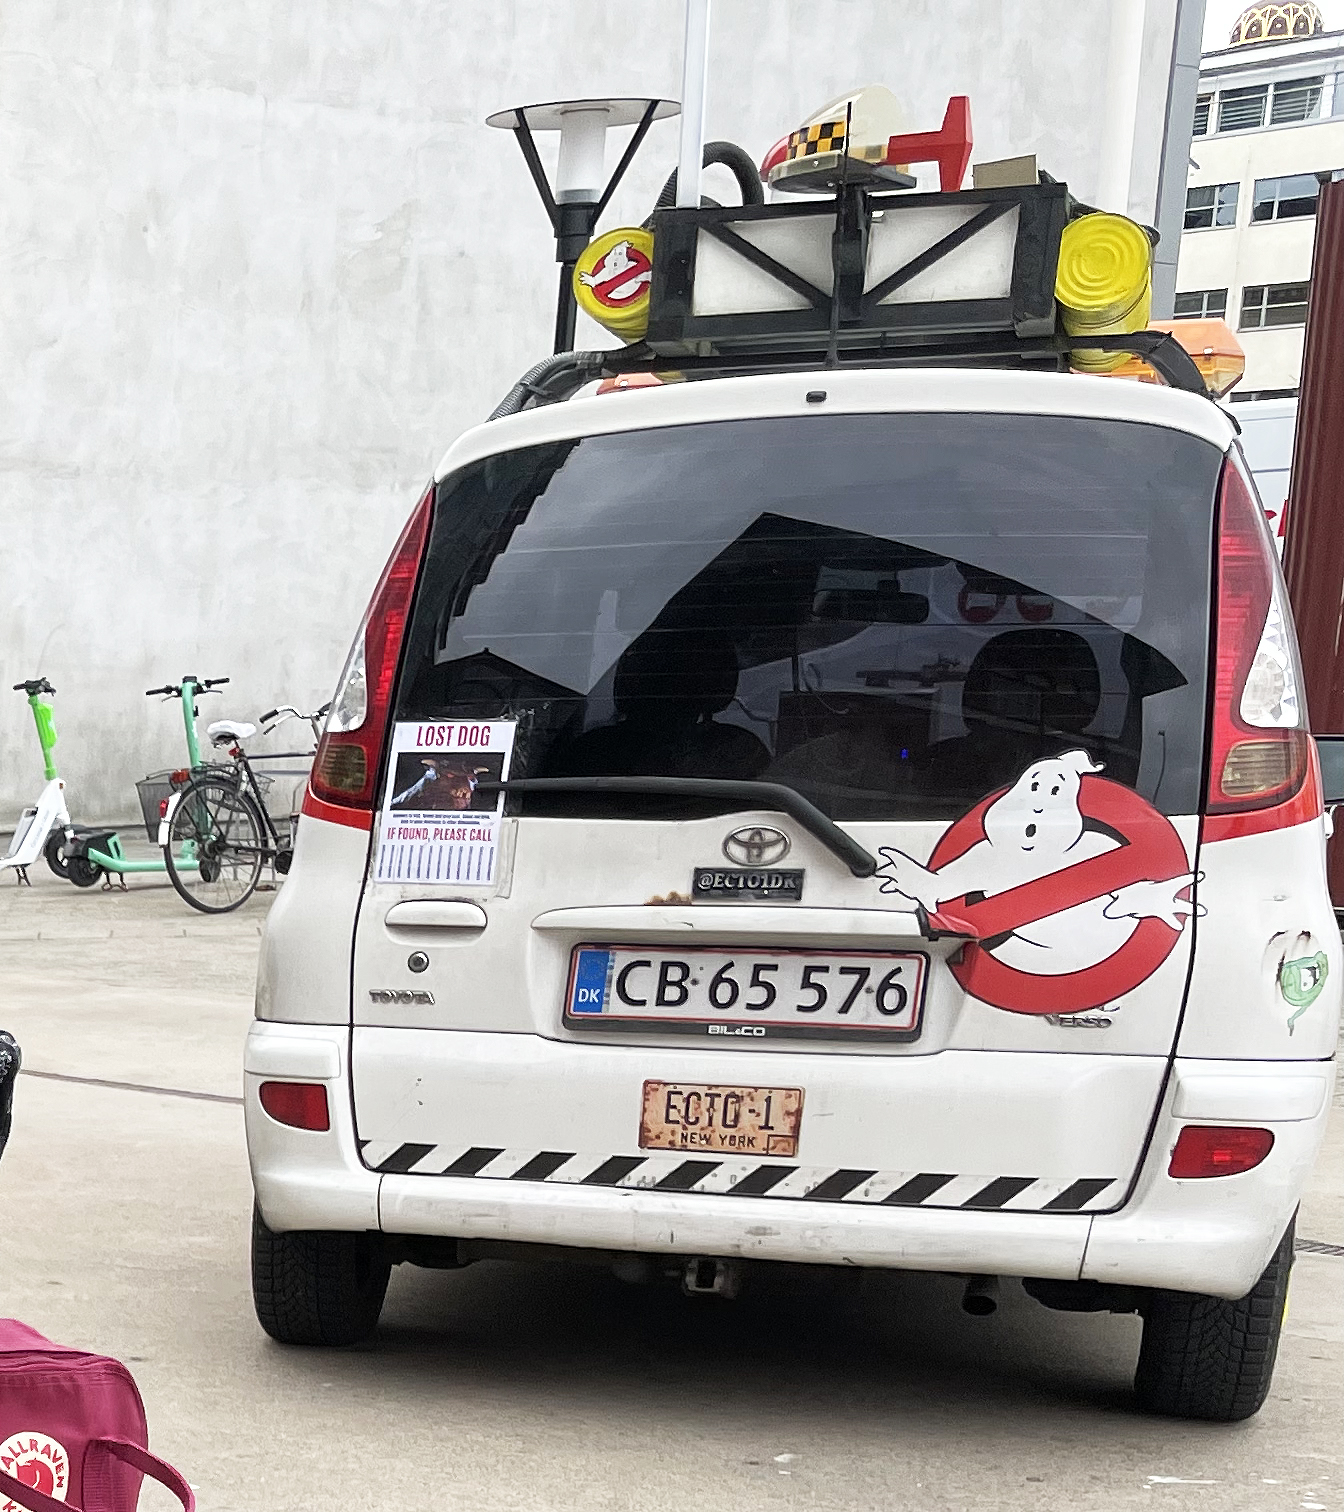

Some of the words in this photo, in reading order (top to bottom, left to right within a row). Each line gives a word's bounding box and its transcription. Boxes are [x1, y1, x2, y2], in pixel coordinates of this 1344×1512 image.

[416, 725, 454, 747] LOST
[457, 725, 491, 747] DOG
[387, 827, 397, 840] IF
[397, 828, 431, 842] FOUND,
[432, 828, 467, 841] PLEASE
[469, 829, 492, 842] CALL
[578, 988, 601, 1003] DK
[615, 960, 691, 1007] CB
[708, 960, 779, 1011] 65
[796, 965, 909, 1016] 576
[680, 1132, 711, 1145] NEW
[719, 1134, 756, 1148] YORK
[0, 1438, 65, 1488] ALLRAVEN
